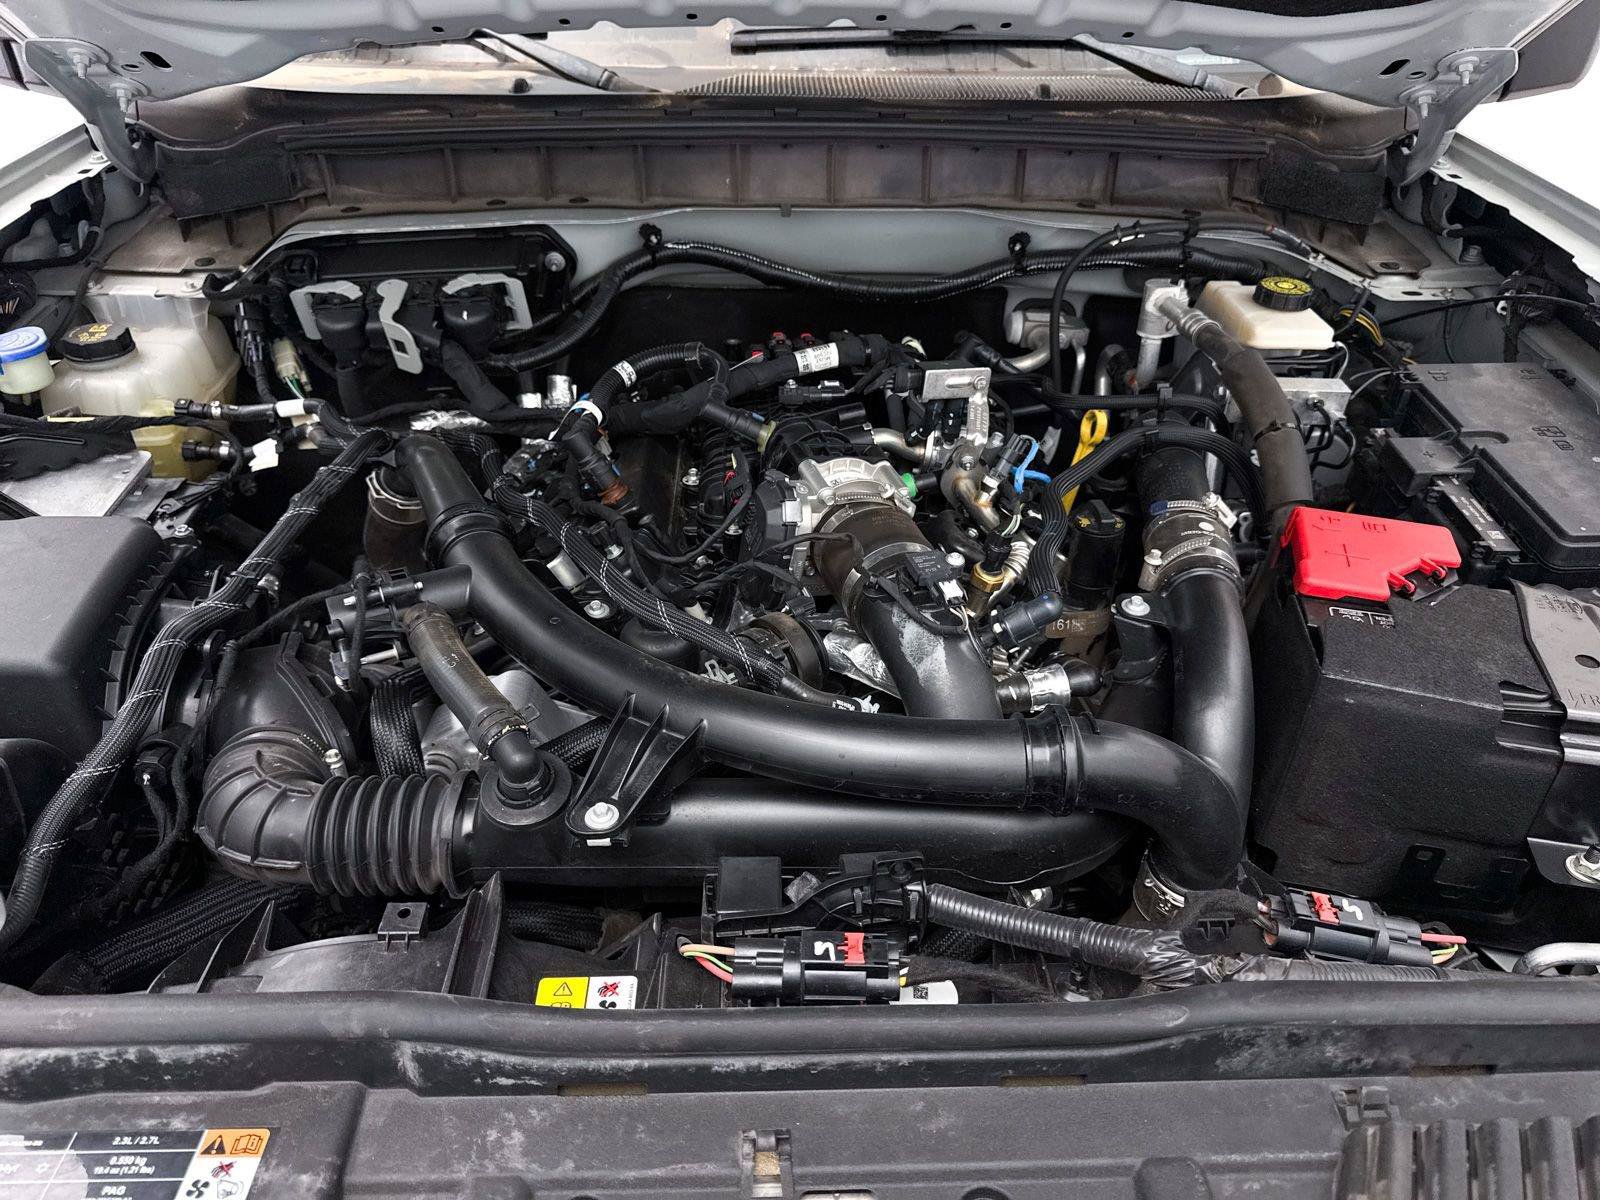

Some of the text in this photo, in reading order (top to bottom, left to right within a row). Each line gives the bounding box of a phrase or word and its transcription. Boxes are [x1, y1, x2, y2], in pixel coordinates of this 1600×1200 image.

[112, 1136, 132, 1145] 2.3L
[140, 1136, 160, 1145] 2.7L
[134, 1156, 147, 1166] kg
[102, 1186, 127, 1195] PAG
